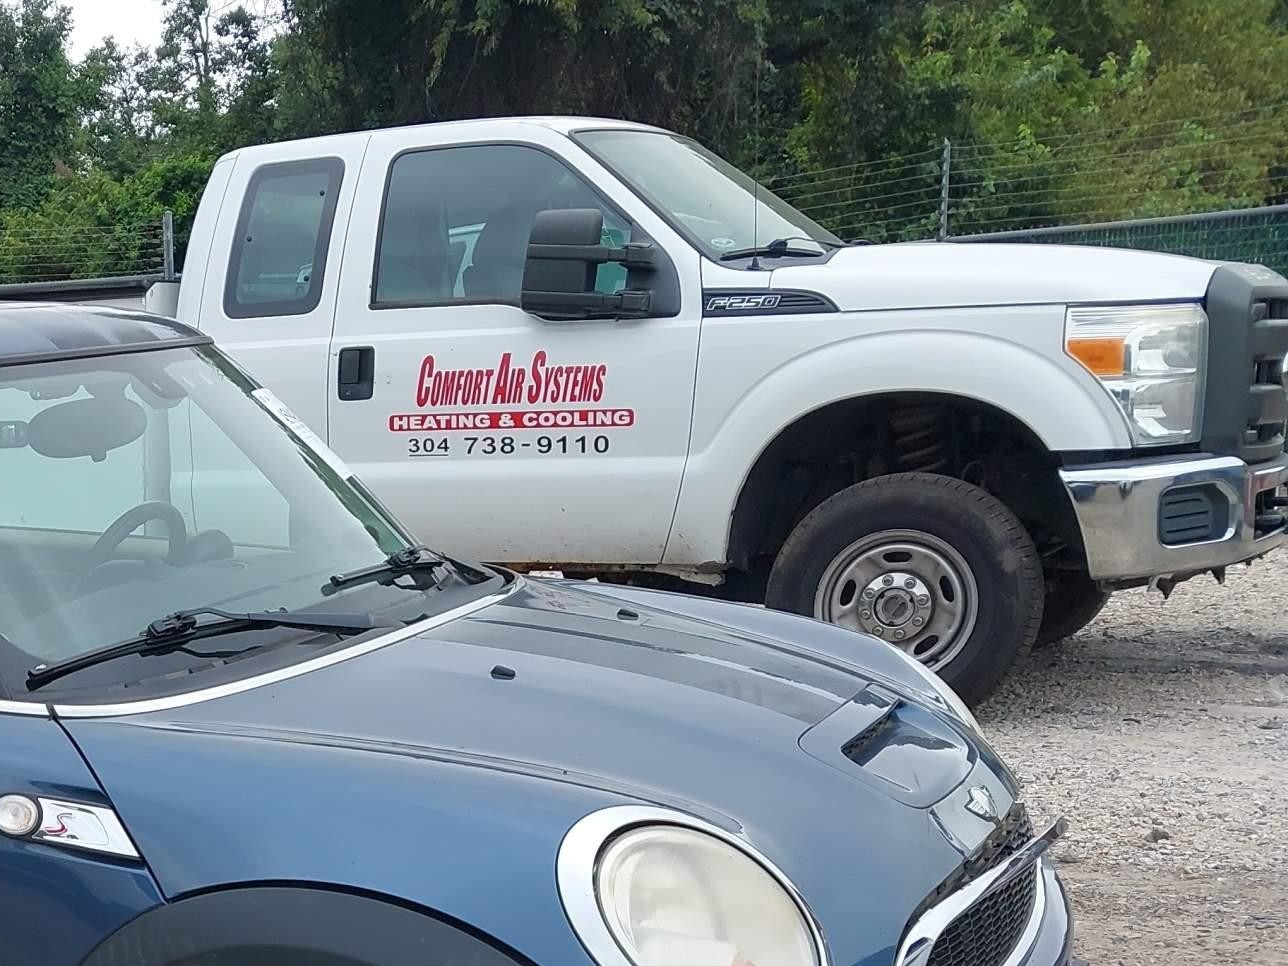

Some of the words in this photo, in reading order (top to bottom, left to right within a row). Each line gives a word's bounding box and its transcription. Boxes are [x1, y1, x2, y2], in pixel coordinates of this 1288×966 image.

[392, 414, 491, 430] HEATING
[498, 413, 516, 428] &
[522, 410, 631, 427] COOLING
[408, 438, 450, 453] 304
[463, 435, 610, 454] 738-9110
